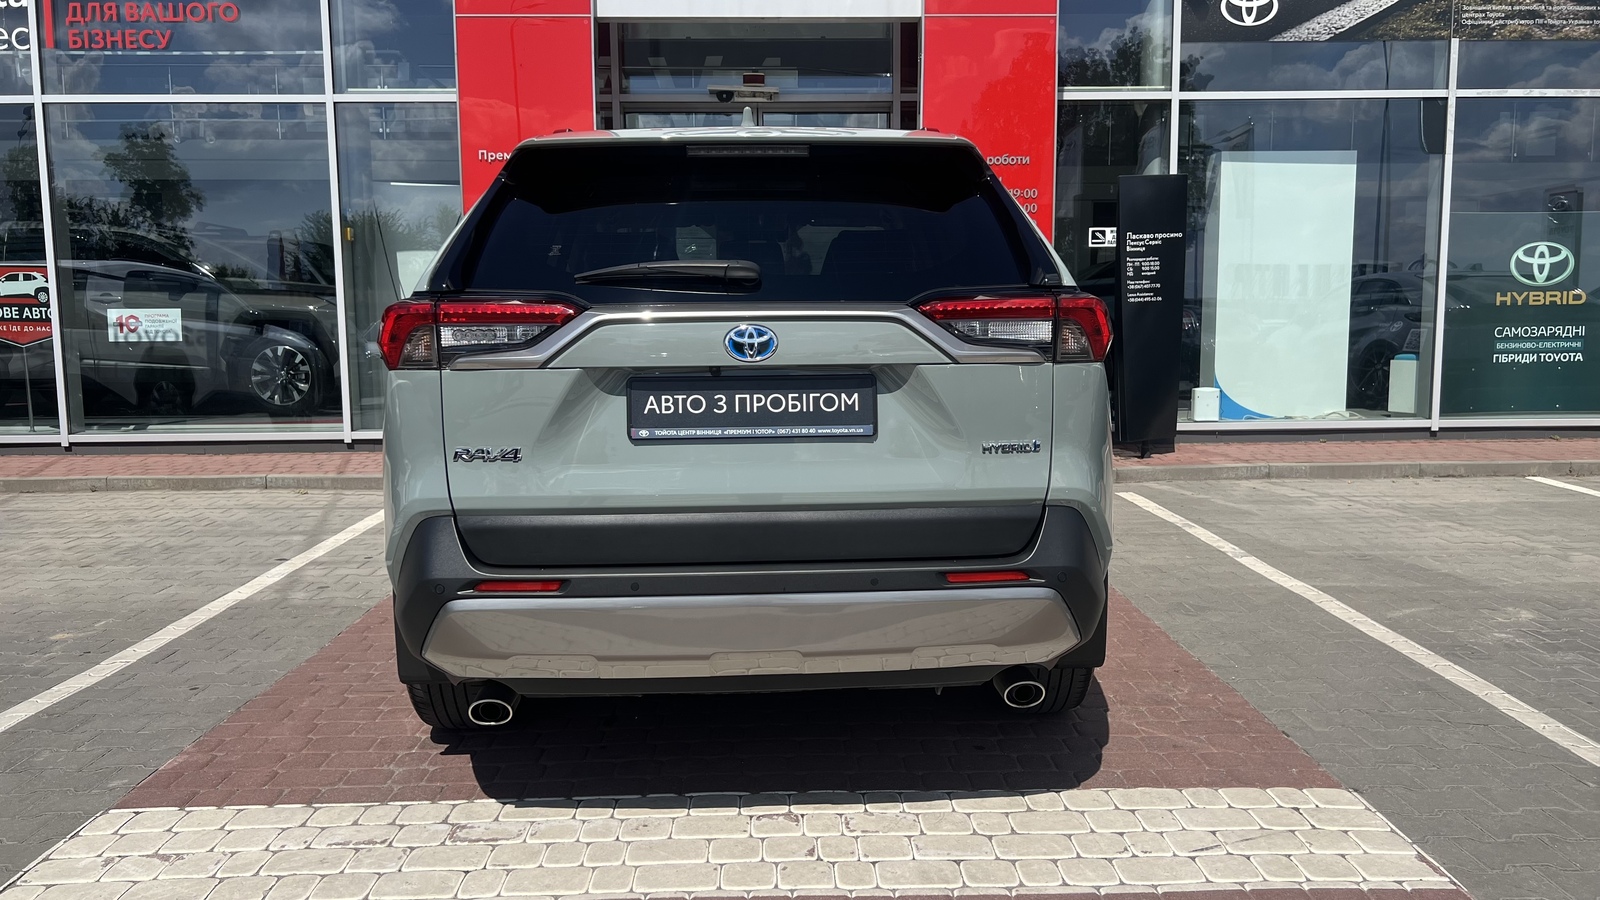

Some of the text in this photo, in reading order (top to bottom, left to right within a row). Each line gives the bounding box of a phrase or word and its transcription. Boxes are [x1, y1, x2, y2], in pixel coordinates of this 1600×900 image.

[65, 2, 239, 26] ДЛЯ ВАШОГО
[68, 29, 172, 50] БІЗНЕСУ
[986, 153, 1030, 165] роботи
[1154, 232, 1183, 240] просимо
[1495, 290, 1587, 306] HYBRID
[0, 306, 20, 319] ВЕ
[9, 324, 21, 332] ЇДЕ
[1494, 325, 1586, 338] САМОЗАРЯДНІ
[1496, 341, 1581, 349] БЕНЗИНОВО-ЕЛЕКТРИЧНІ
[1492, 352, 1583, 364] ГІБРИДИ TOYOTA
[643, 392, 860, 415] АВТО З ПРОБІГОМ
[453, 447, 522, 463] RAV4
